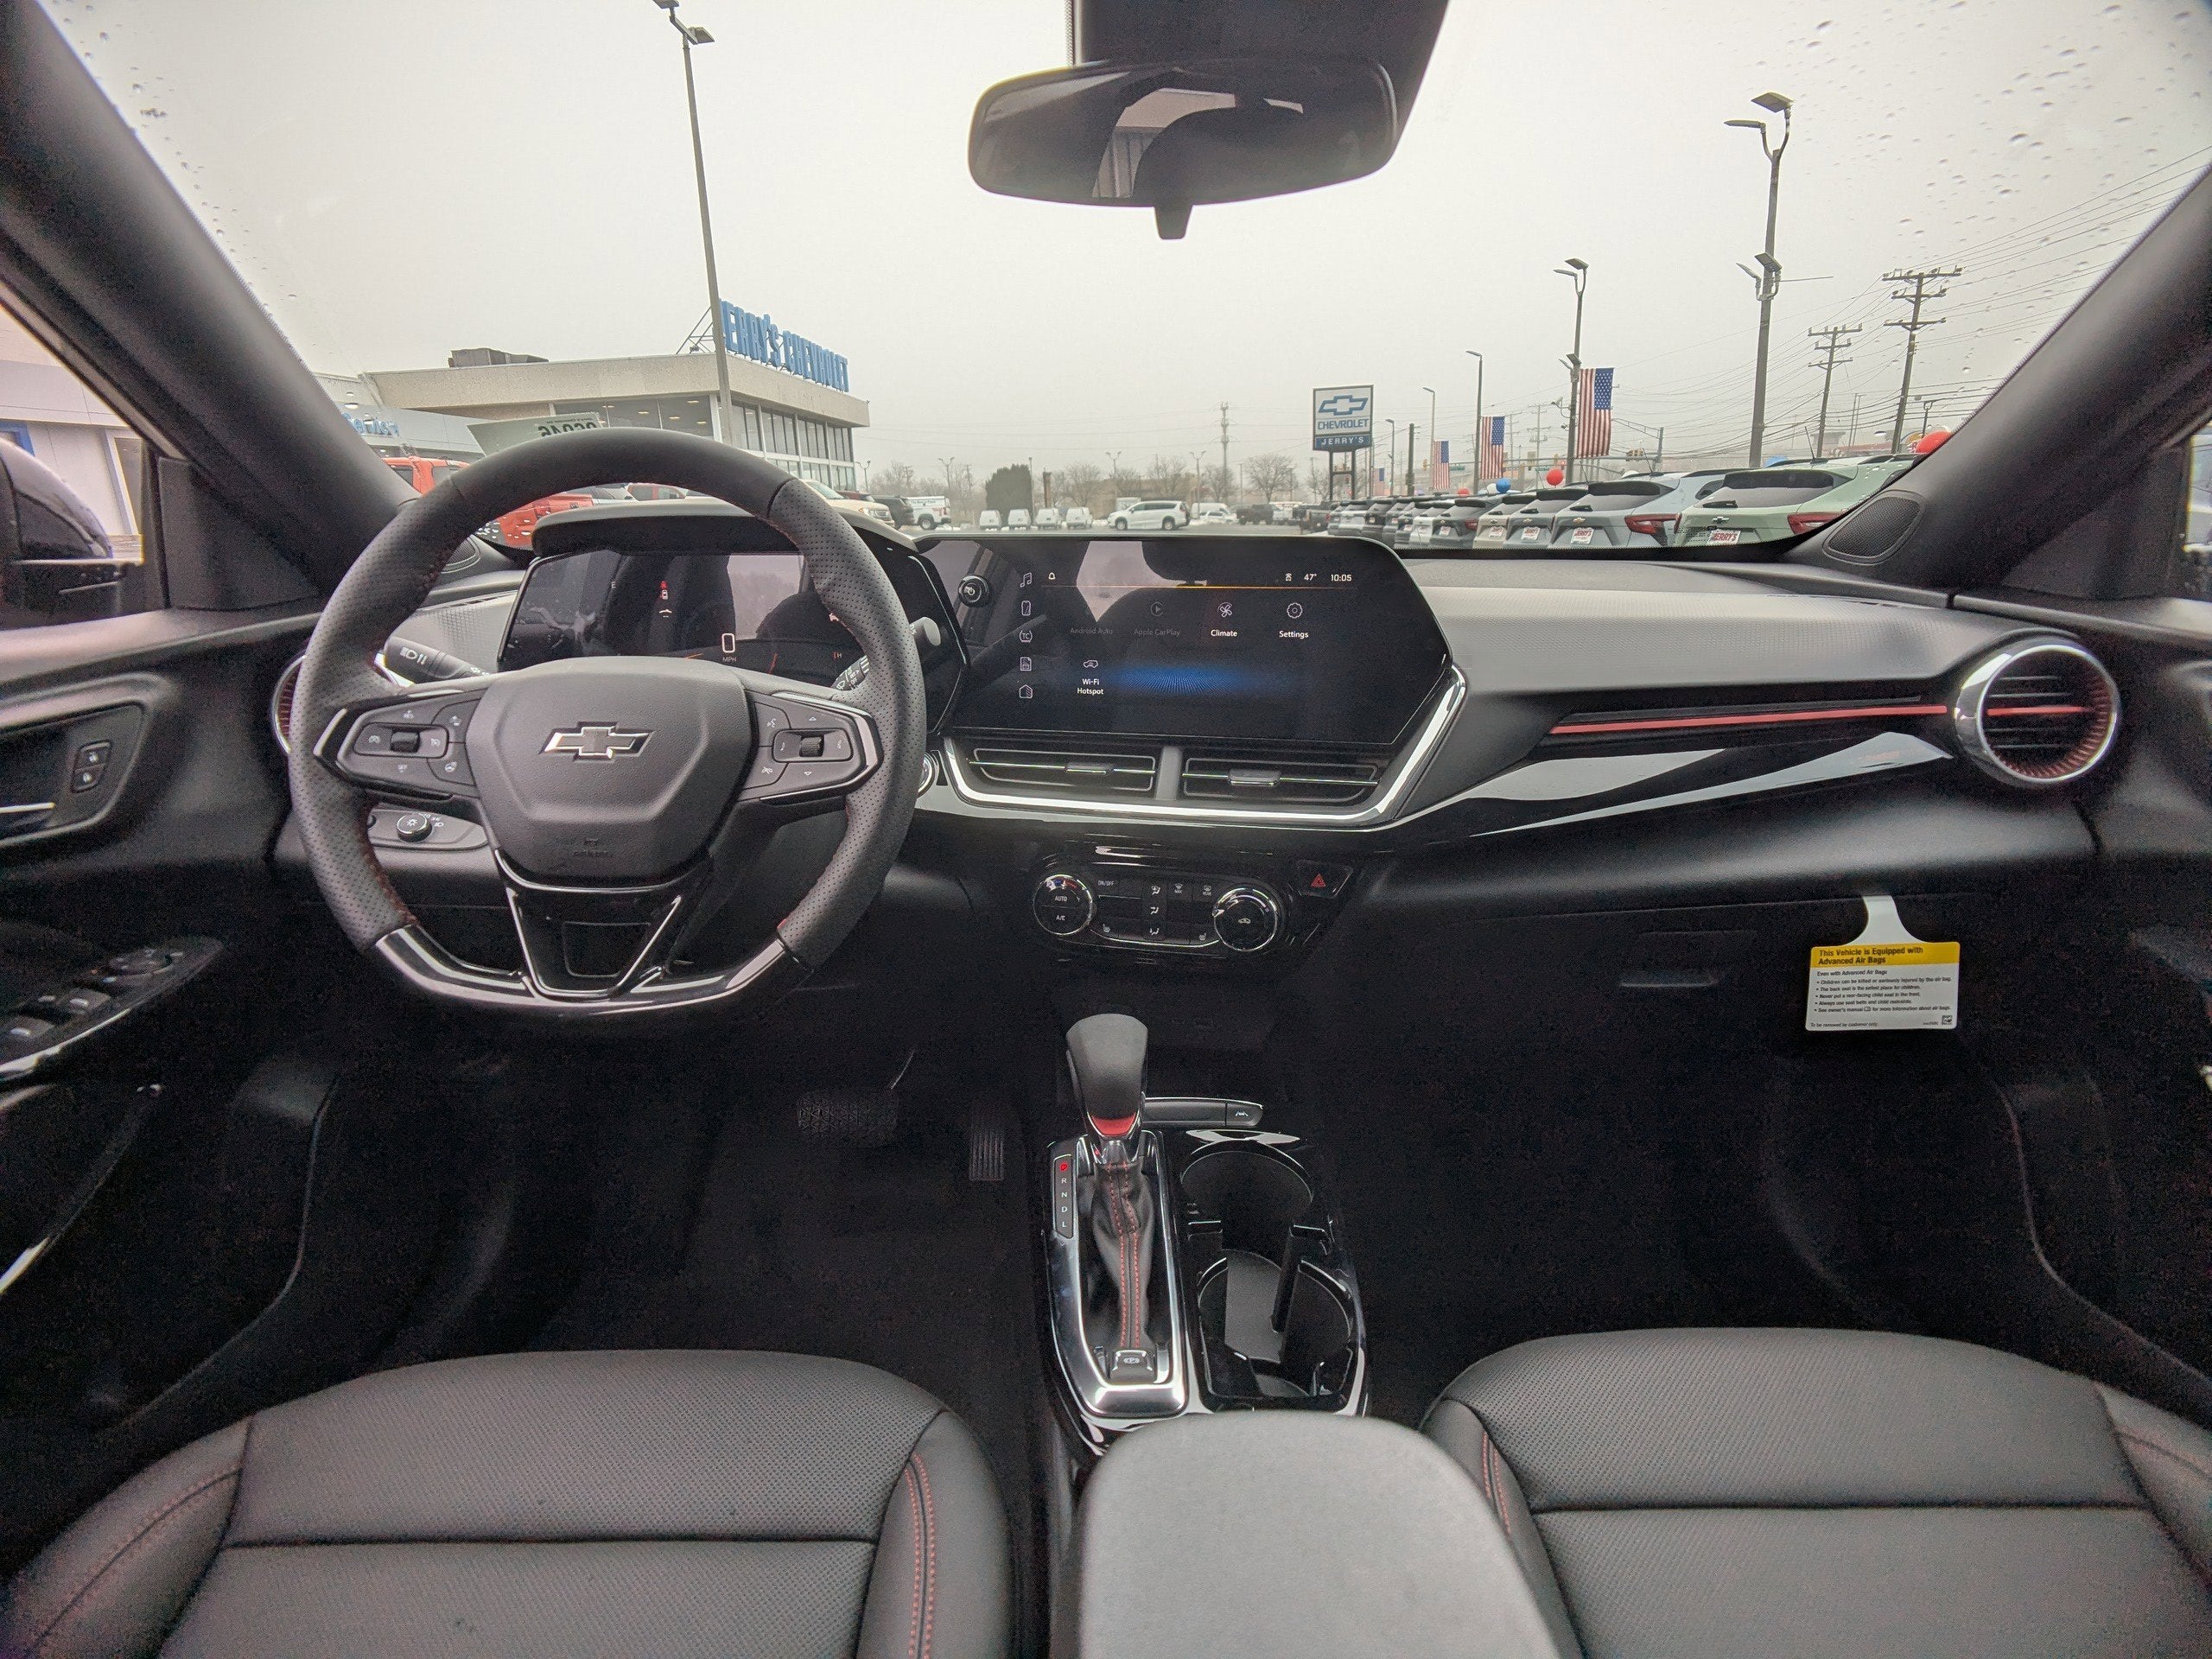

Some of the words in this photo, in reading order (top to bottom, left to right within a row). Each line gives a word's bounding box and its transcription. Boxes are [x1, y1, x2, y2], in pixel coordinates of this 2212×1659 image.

[719, 300, 781, 367] ERRY'S
[783, 330, 849, 392] CHEVROLET
[1318, 418, 1369, 429] CHEVROLET
[1321, 436, 1364, 445] JERRY'S
[1154, 628, 1181, 637] CarPlay
[1279, 630, 1309, 639] Settings
[721, 632, 735, 653] 0
[1872, 947, 1905, 956] Equipped
